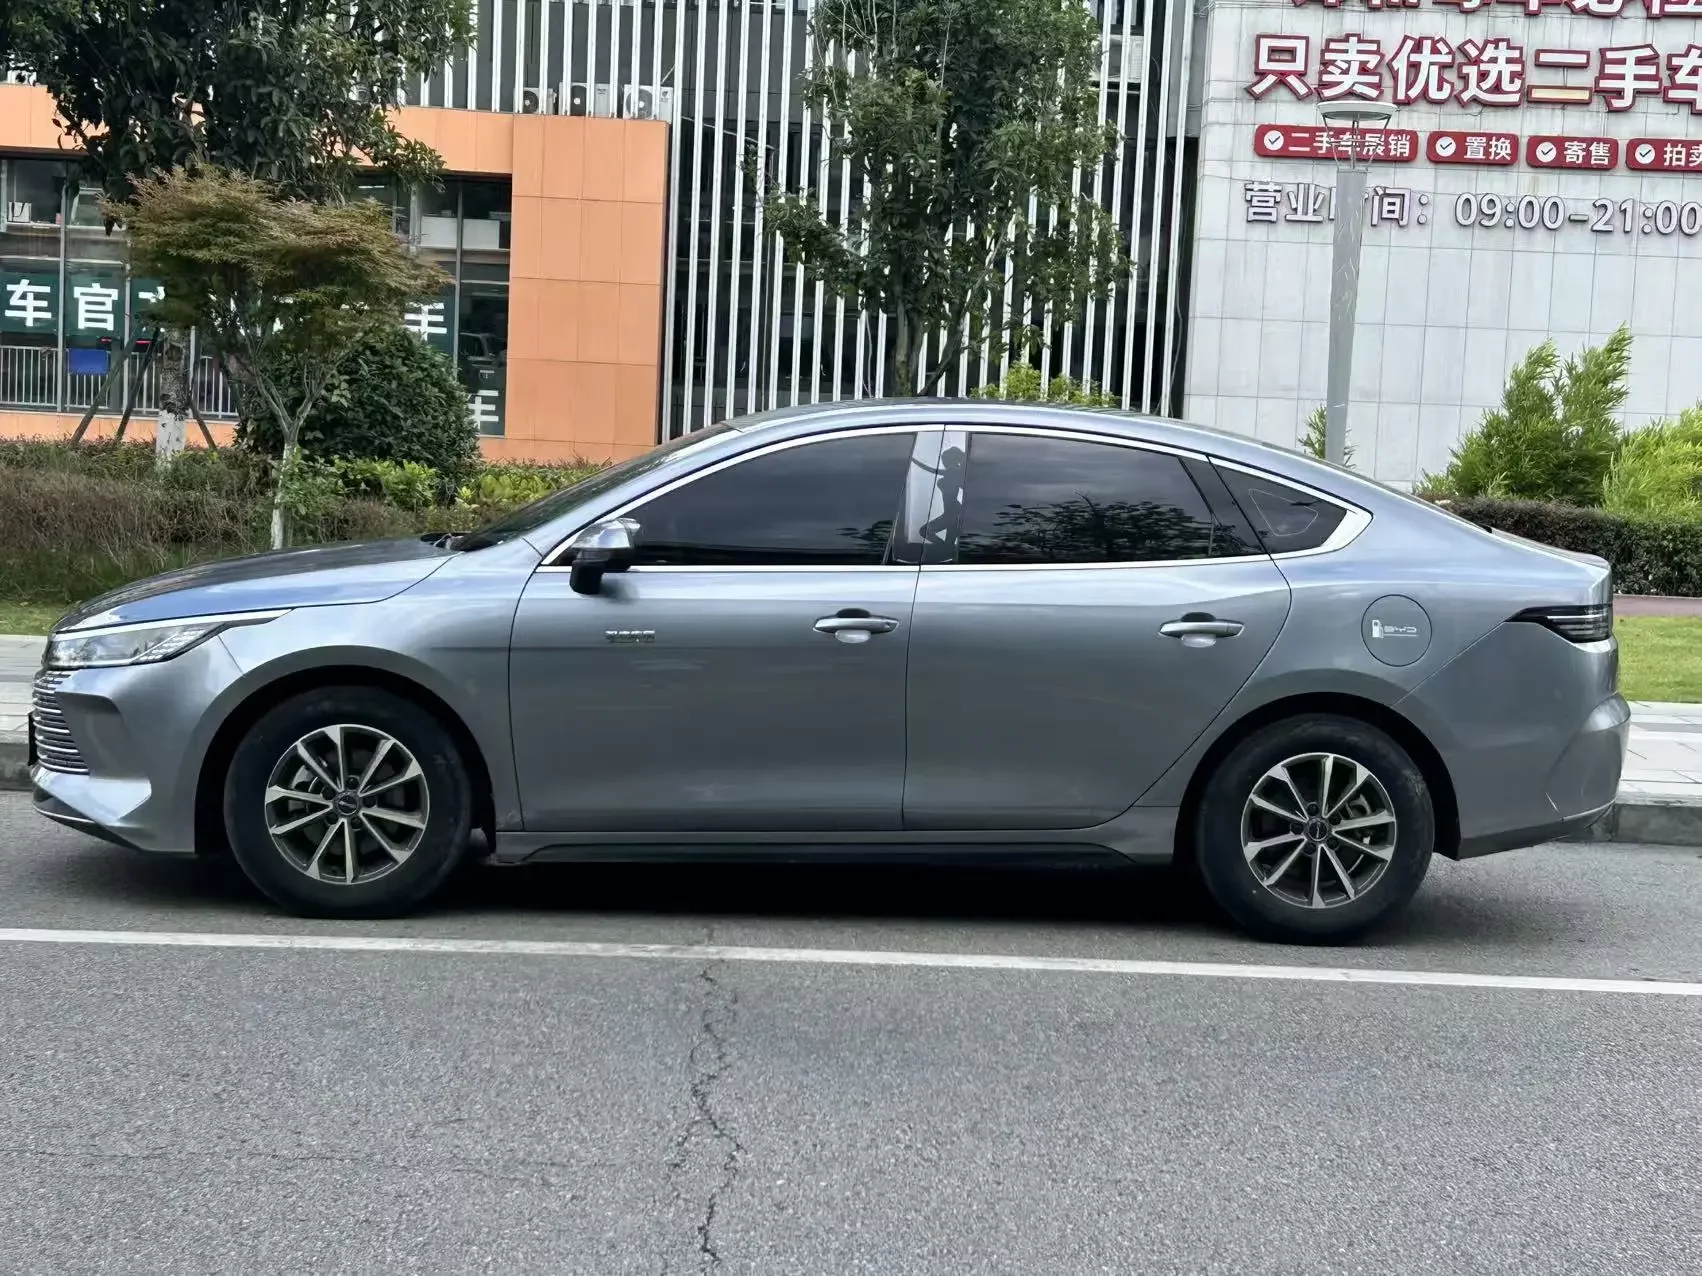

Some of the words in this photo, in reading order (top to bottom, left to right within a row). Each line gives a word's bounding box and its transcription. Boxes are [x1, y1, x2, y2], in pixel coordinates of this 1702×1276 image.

[1464, 136, 1511, 160] 置换
[1563, 141, 1611, 165] 寄售
[1244, 181, 1430, 228] 营业间：
[1455, 192, 1702, 236] 09:00-21:00
[4, 278, 166, 332] 车官
